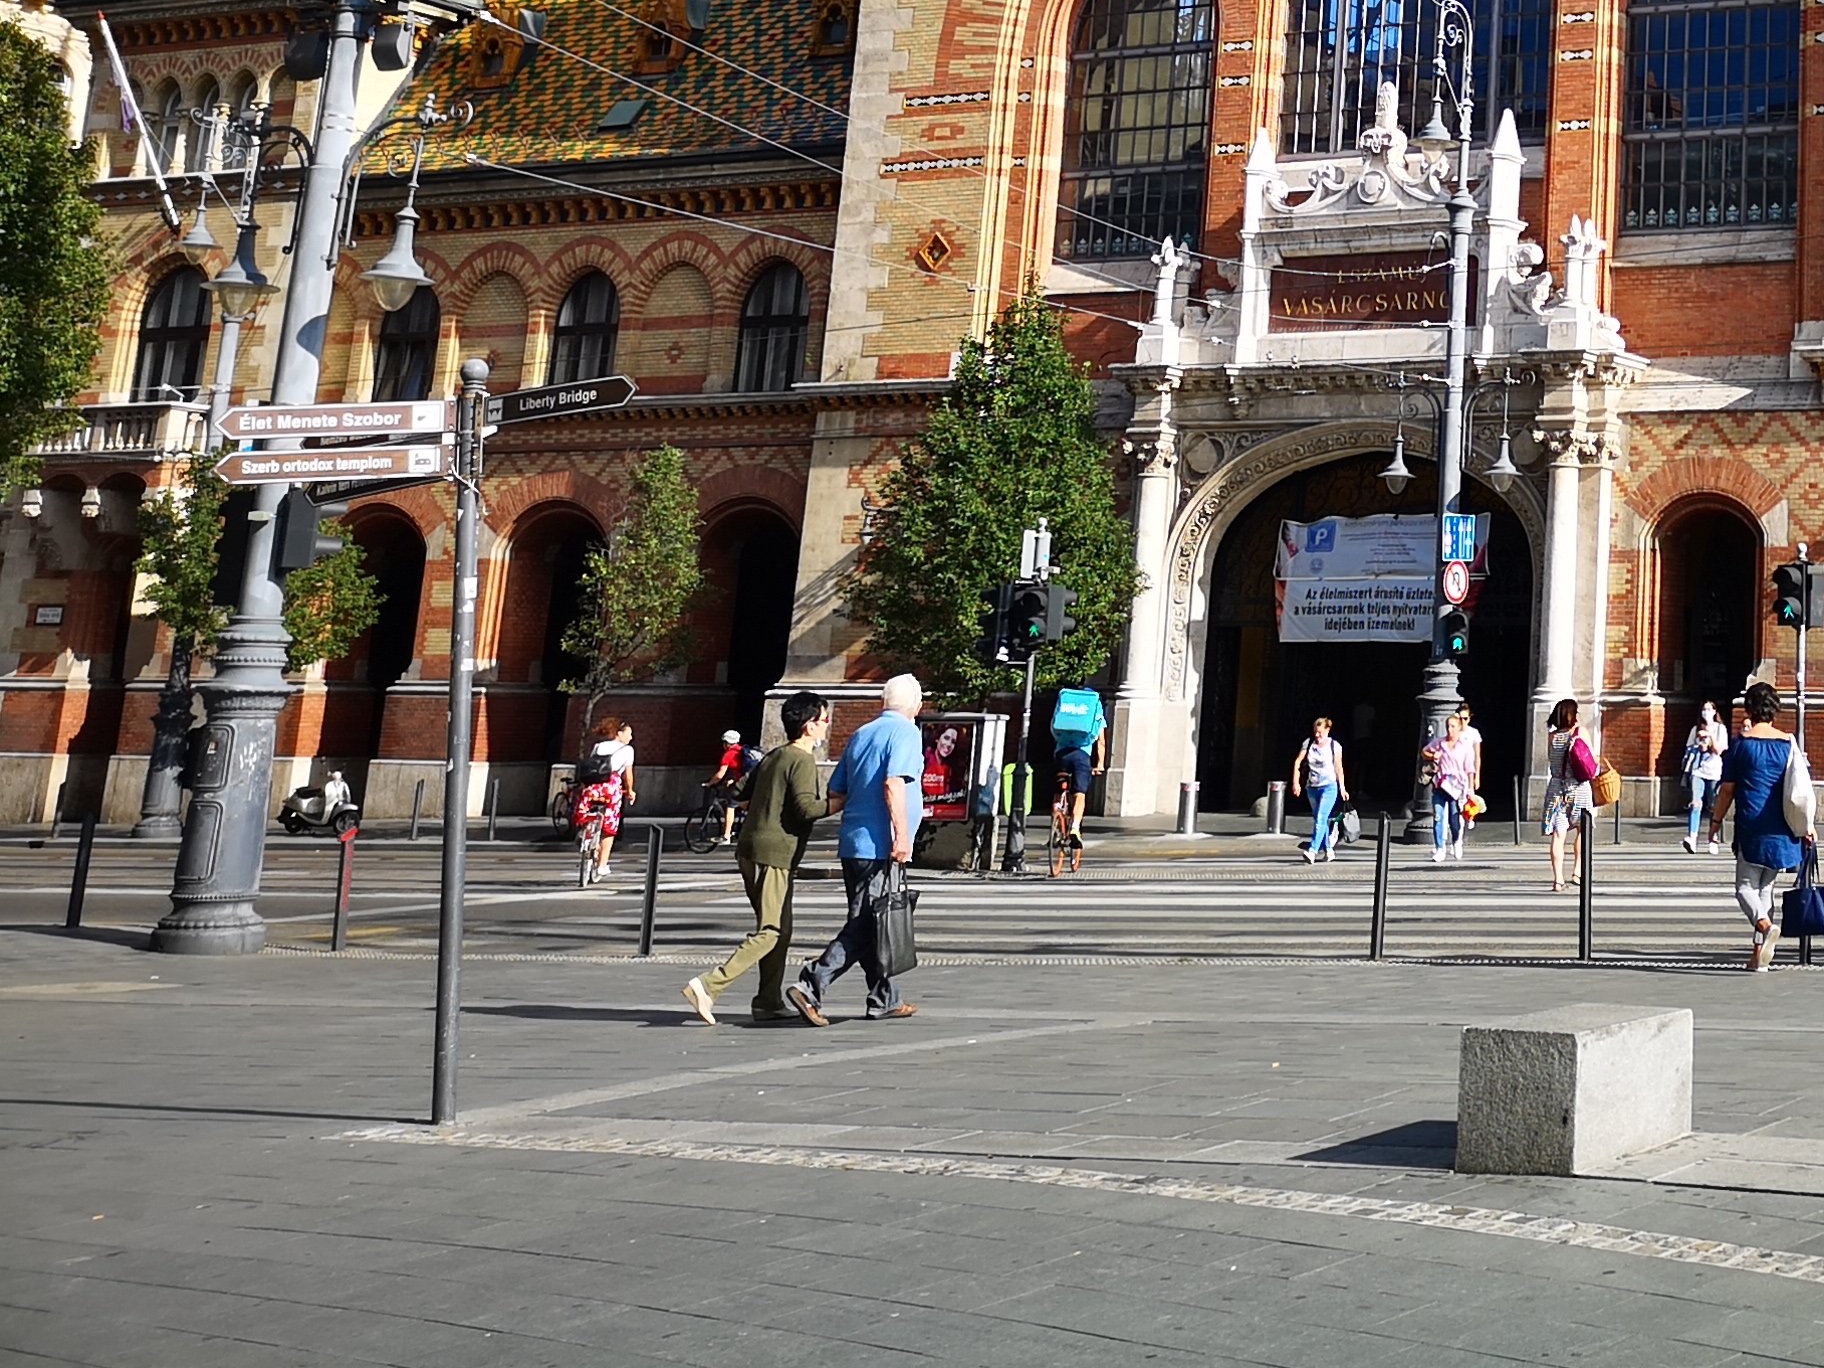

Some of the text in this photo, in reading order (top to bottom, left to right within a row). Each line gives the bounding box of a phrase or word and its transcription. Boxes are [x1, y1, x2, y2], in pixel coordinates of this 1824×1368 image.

[1282, 288, 1451, 317] VÁSÁRCSARNO
[519, 389, 598, 411] Liberty Bridge
[239, 412, 402, 431] Élet Menete Szobor
[241, 455, 393, 475] Szerb ortodox templom
[1306, 588, 1317, 600] Az
[1320, 586, 1373, 601] élelmiszert
[1406, 587, 1434, 601] üzlete
[1302, 602, 1365, 616] vásárcsarnok
[1324, 616, 1365, 633] idejében
